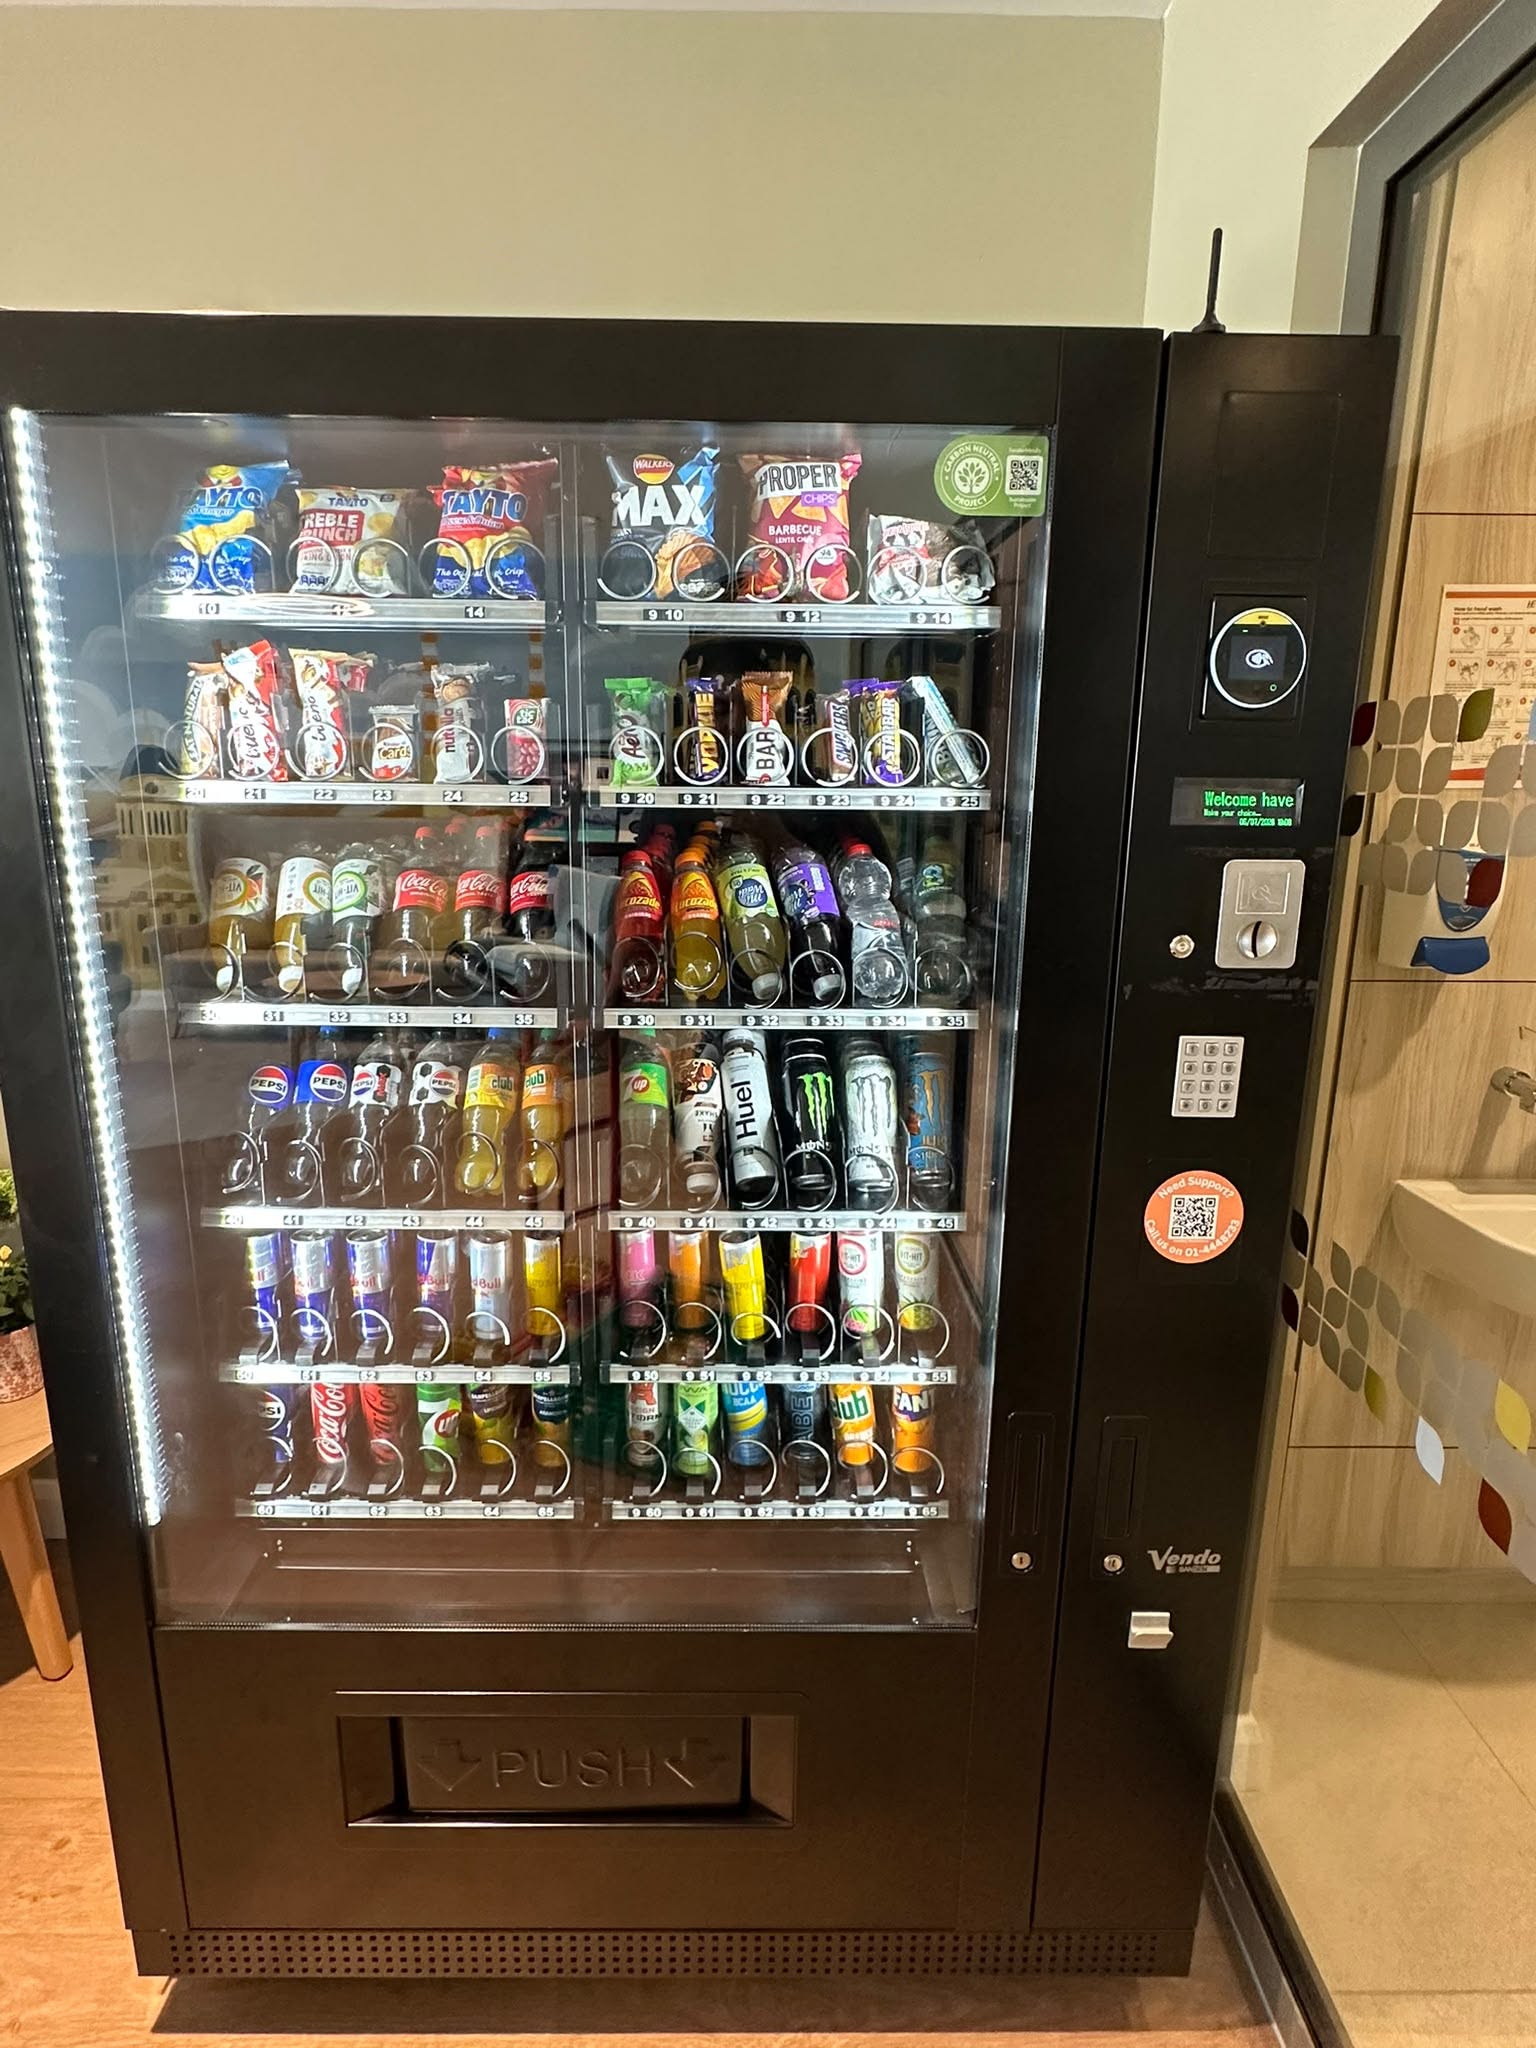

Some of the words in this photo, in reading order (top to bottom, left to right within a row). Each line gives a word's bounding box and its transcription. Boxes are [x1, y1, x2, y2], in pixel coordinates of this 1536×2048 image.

[944, 445, 971, 473] CARBON
[973, 444, 1001, 473] NEUTRAL
[759, 463, 838, 496] PROPER
[328, 497, 369, 507] TAYTO
[803, 493, 836, 504] CHIPS
[953, 494, 988, 507] PROJECT
[442, 487, 528, 522] TAYTO
[612, 485, 706, 527] MAX
[768, 524, 822, 536] BARBECUE
[436, 568, 451, 577] The
[505, 567, 524, 577] Crisp
[466, 607, 484, 618] 14
[649, 609, 657, 620] 9
[666, 610, 682, 620] 10
[786, 611, 795, 622] 9
[803, 611, 820, 621] 12
[917, 613, 925, 624] 9
[934, 613, 950, 623] 14
[519, 708, 536, 717] tic
[516, 716, 534, 724] tac
[617, 714, 646, 758] Aero
[756, 731, 775, 770] BAR
[316, 789, 334, 800] 22
[374, 789, 391, 801] 23
[444, 790, 462, 801] 24
[510, 791, 528, 803] 25
[621, 794, 629, 804] 9
[637, 794, 654, 804] 20
[684, 794, 692, 805] 9
[699, 794, 715, 804] 21
[752, 795, 760, 805] 9
[767, 795, 784, 805] 22
[1204, 791, 1257, 806] Welcome
[1262, 791, 1294, 808] have
[817, 795, 825, 806] 9
[832, 795, 849, 805] 23
[881, 795, 889, 806] 9
[896, 795, 914, 805] 24
[946, 796, 955, 807] 9
[961, 796, 978, 807] 25
[1221, 809, 1234, 817] your
[265, 1011, 280, 1021] 31
[331, 1011, 349, 1022] 32
[389, 1012, 407, 1023] 33
[454, 1013, 472, 1024] 34
[516, 1014, 534, 1025] 35
[623, 1016, 631, 1026] 9
[637, 1015, 654, 1026] 30
[685, 1016, 693, 1026] 9
[698, 1015, 713, 1026] 31
[747, 1016, 755, 1026] 9
[762, 1016, 779, 1026] 32
[811, 1016, 820, 1026] 9
[825, 1016, 843, 1026] 33
[872, 1016, 881, 1026] 9
[888, 1016, 905, 1026] 34
[932, 1017, 941, 1027] 9
[947, 1016, 964, 1027] 35
[313, 1077, 345, 1091] PEPSI
[492, 1075, 512, 1091] club
[525, 1070, 544, 1088] club
[252, 1079, 286, 1093] PEPSI
[730, 1080, 758, 1140] Huel
[1157, 1177, 1187, 1199] Need
[1187, 1176, 1235, 1198] Support?
[284, 1215, 299, 1225] 41
[346, 1215, 364, 1226] 42
[403, 1216, 421, 1227] 43
[466, 1216, 483, 1227] 44
[525, 1217, 543, 1228] 45
[625, 1217, 633, 1228] 9
[638, 1217, 656, 1227] 40
[684, 1218, 693, 1228] 9
[698, 1217, 713, 1228] 41
[747, 1218, 755, 1228] 9
[760, 1218, 777, 1228] 42
[804, 1218, 813, 1228] 9
[818, 1218, 835, 1228] 43
[865, 1218, 874, 1229] 9
[879, 1218, 897, 1228] 44
[923, 1218, 932, 1229] 9
[938, 1218, 954, 1229] 45
[1146, 1219, 1161, 1240] Call
[1156, 1239, 1170, 1250] us
[1168, 1246, 1183, 1256] on
[1185, 1219, 1240, 1257] 01-4448233
[479, 1277, 501, 1289] Bull
[535, 1371, 551, 1382] 55
[632, 1371, 640, 1381] 9
[644, 1371, 659, 1381] 50
[686, 1371, 694, 1381] 9
[700, 1371, 714, 1381] 51
[932, 1371, 948, 1382] 55
[733, 1397, 757, 1407] BCAA
[257, 1505, 274, 1515] 60
[313, 1505, 328, 1516] 61
[370, 1505, 387, 1516] 62
[425, 1506, 442, 1516] 63
[484, 1506, 500, 1517] 64
[538, 1506, 554, 1517] 65
[632, 1508, 640, 1518] 9
[646, 1507, 662, 1517] 60
[686, 1508, 694, 1518] 9
[699, 1507, 714, 1517] 61
[757, 1507, 774, 1517] 62
[808, 1508, 825, 1517] 63
[923, 1507, 938, 1517] 65
[1146, 1545, 1222, 1571] Vendo
[492, 1747, 653, 1789] PUSH
